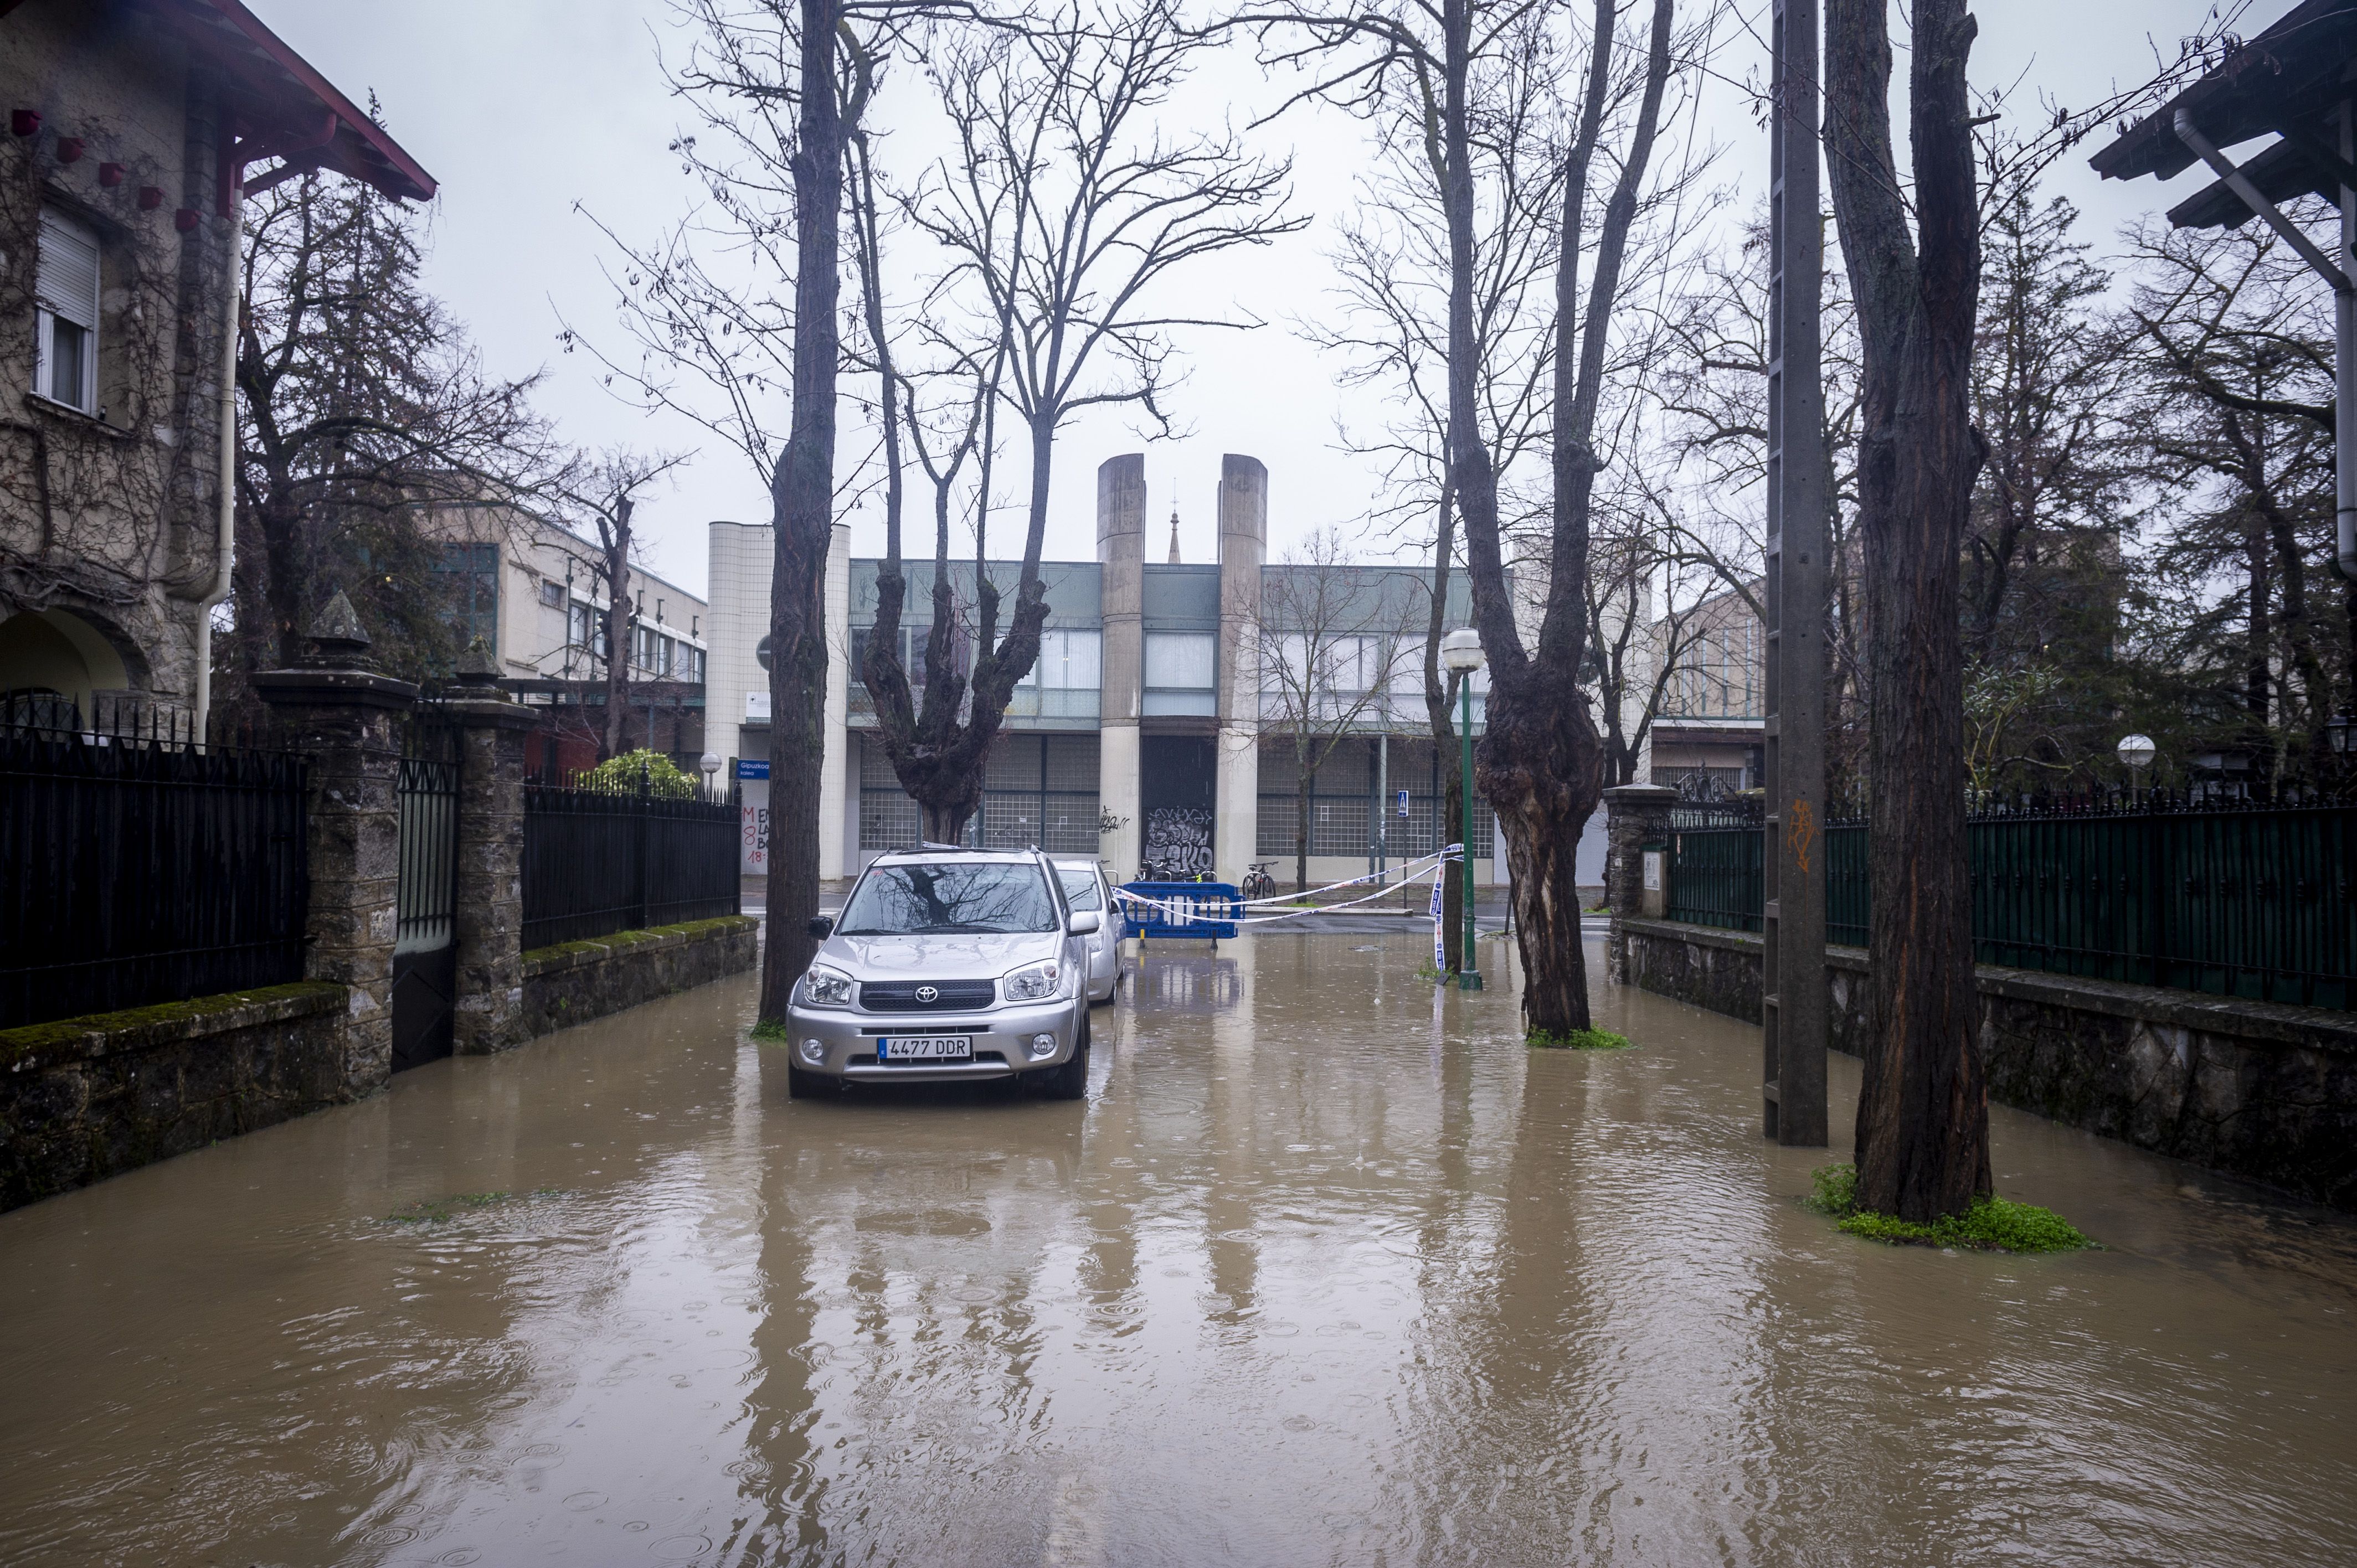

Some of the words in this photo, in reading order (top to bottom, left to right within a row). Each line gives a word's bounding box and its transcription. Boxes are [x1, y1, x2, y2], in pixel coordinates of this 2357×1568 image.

[743, 806, 754, 823] M
[743, 826, 756, 845] 8
[891, 1040, 930, 1055] 4477
[936, 1040, 965, 1054] DDR
